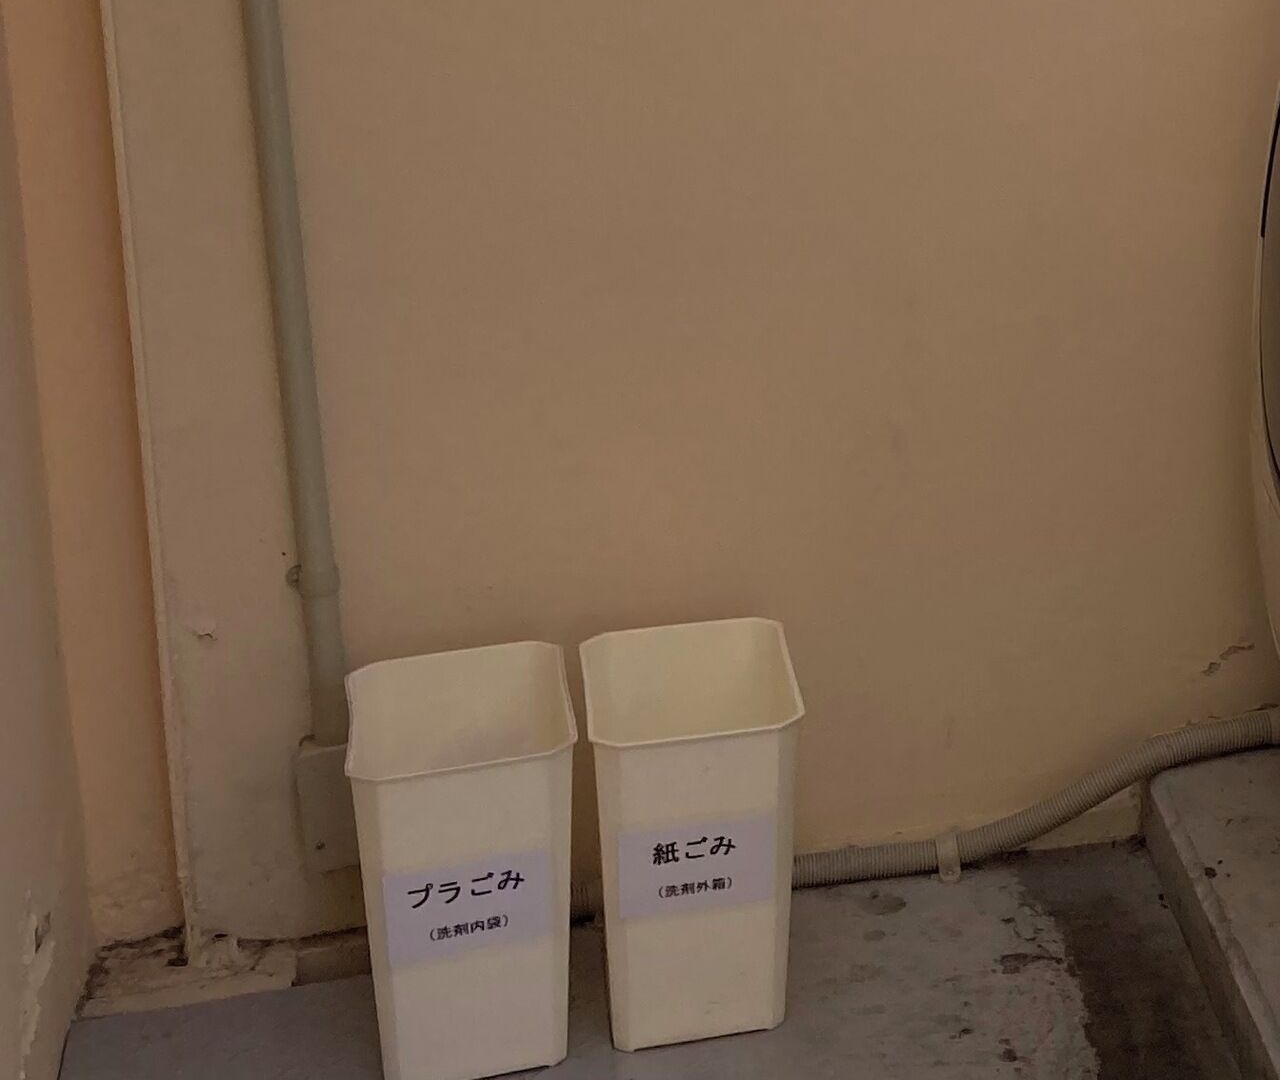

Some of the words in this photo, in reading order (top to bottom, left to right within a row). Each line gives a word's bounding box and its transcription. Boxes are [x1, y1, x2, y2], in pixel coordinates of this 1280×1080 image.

[652, 835, 737, 867] 紙ごみ
[407, 868, 526, 910] プラごみ
